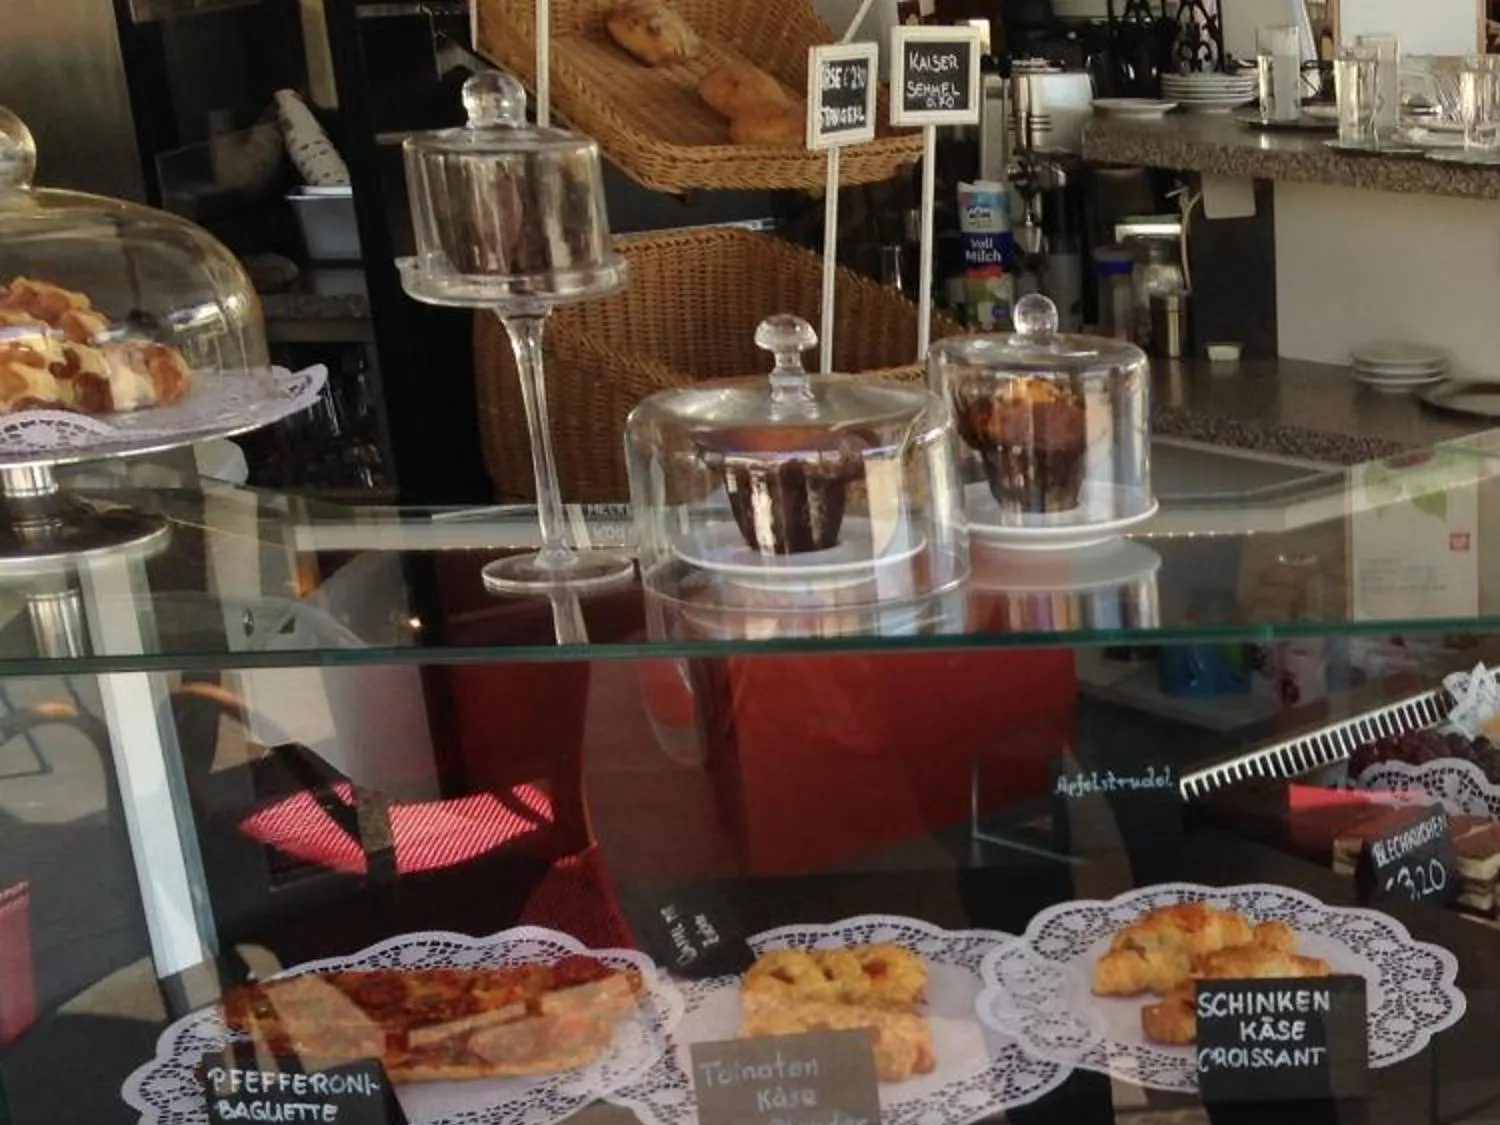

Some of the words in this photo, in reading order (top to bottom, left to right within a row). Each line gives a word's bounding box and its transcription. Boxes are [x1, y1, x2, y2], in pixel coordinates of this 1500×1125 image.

[908, 50, 959, 72] KAISER
[906, 81, 961, 99] SEMMEL
[1054, 764, 1174, 798] Apfelstrudel
[1196, 990, 1331, 1018] SCHINKEN
[1239, 1016, 1307, 1042] KÄSE
[1198, 1047, 1327, 1073] CROISSANT
[217, 1101, 339, 1122] BAGUETTE
